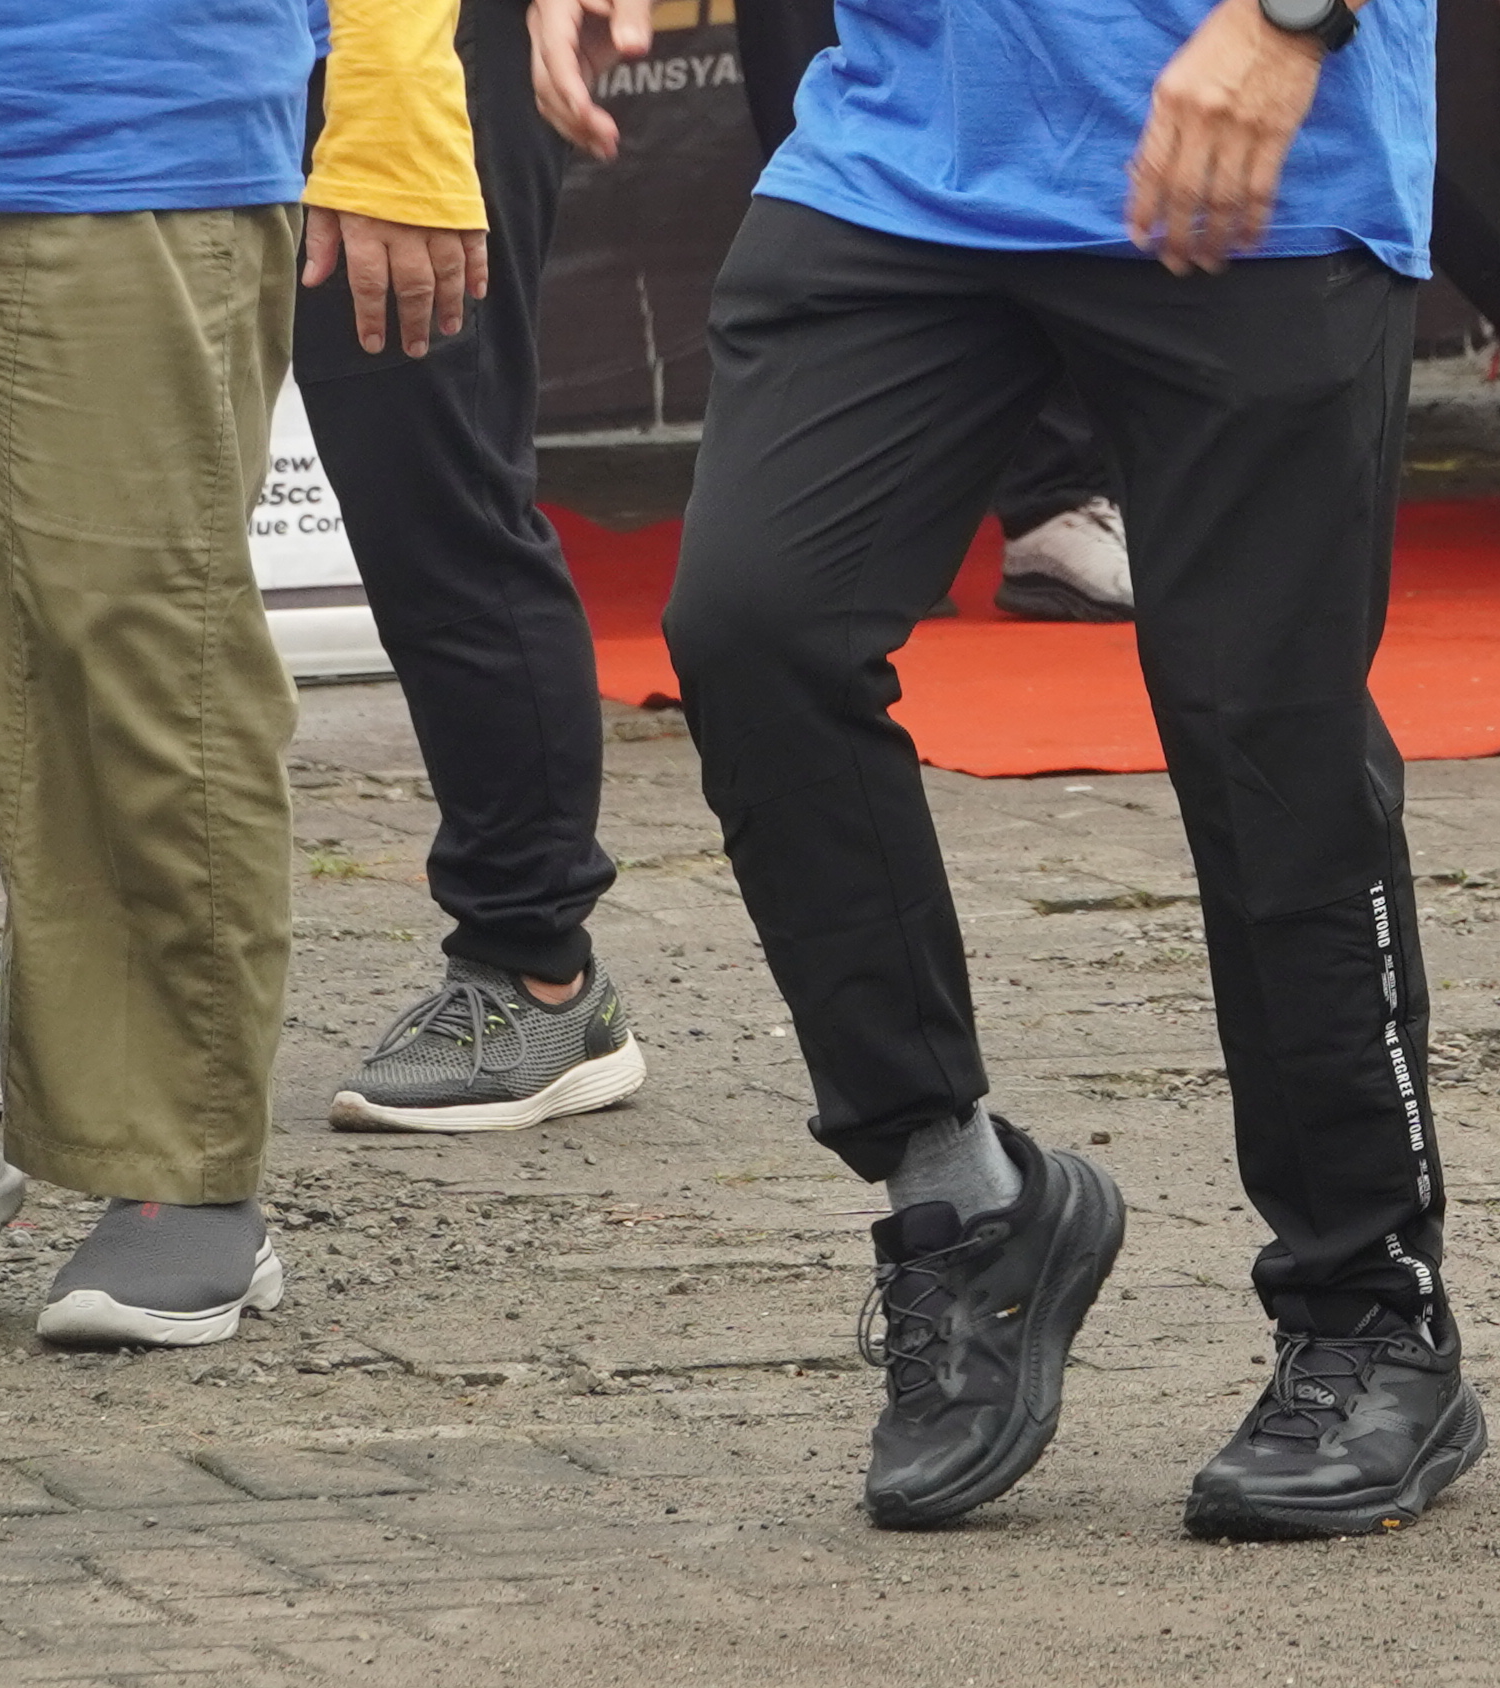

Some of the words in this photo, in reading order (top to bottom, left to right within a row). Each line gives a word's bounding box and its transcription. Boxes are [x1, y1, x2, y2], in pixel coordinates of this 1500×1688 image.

[597, 53, 744, 99] IANSYA
[269, 455, 315, 473] ew
[1372, 896, 1391, 948] BEYOND
[1384, 1020, 1399, 1046] ONE
[1389, 1047, 1415, 1098] DEGREE
[1404, 1099, 1425, 1152] BEYOND
